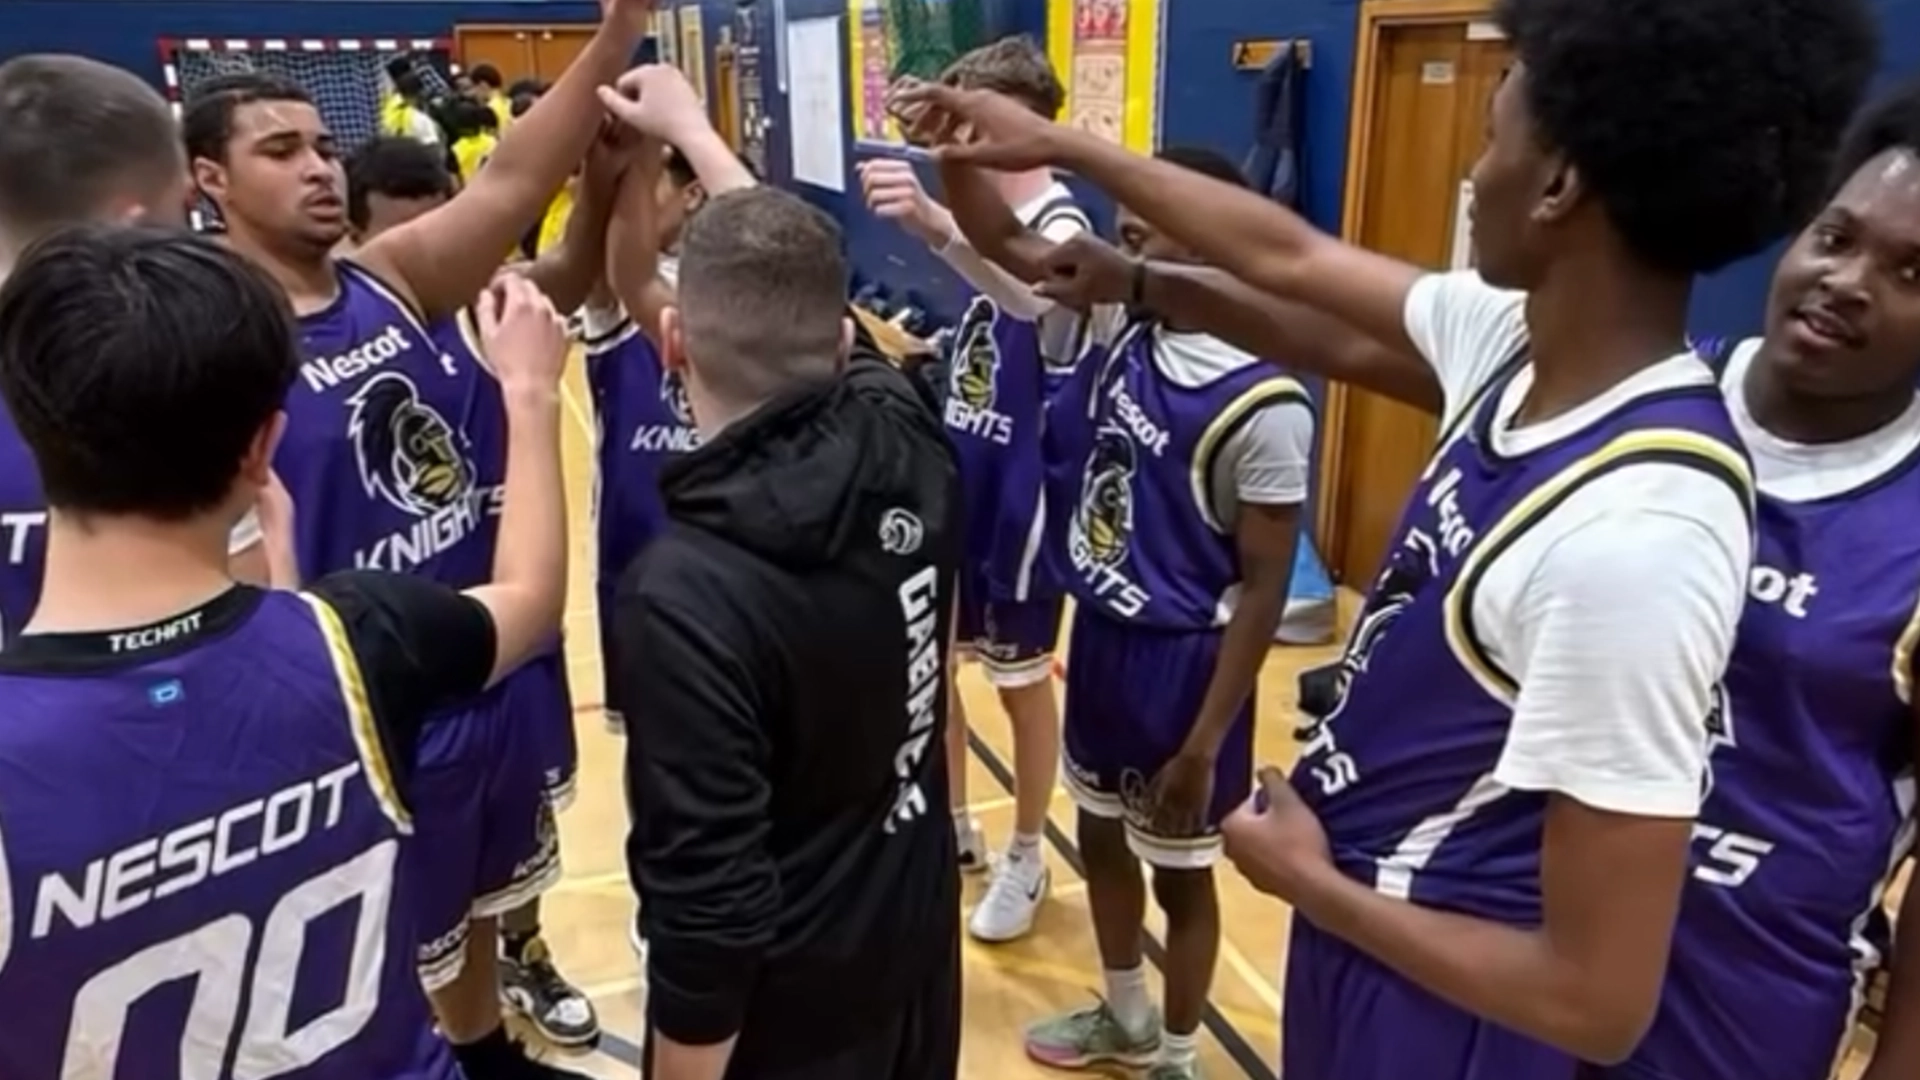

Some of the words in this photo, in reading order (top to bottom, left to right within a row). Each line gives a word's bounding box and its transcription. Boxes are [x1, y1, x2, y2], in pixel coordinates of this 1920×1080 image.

[301, 324, 411, 393] Nescot
[108, 612, 202, 653] TECHFIT
[31, 760, 361, 940] NESCOT
[60, 838, 399, 1080] 00
